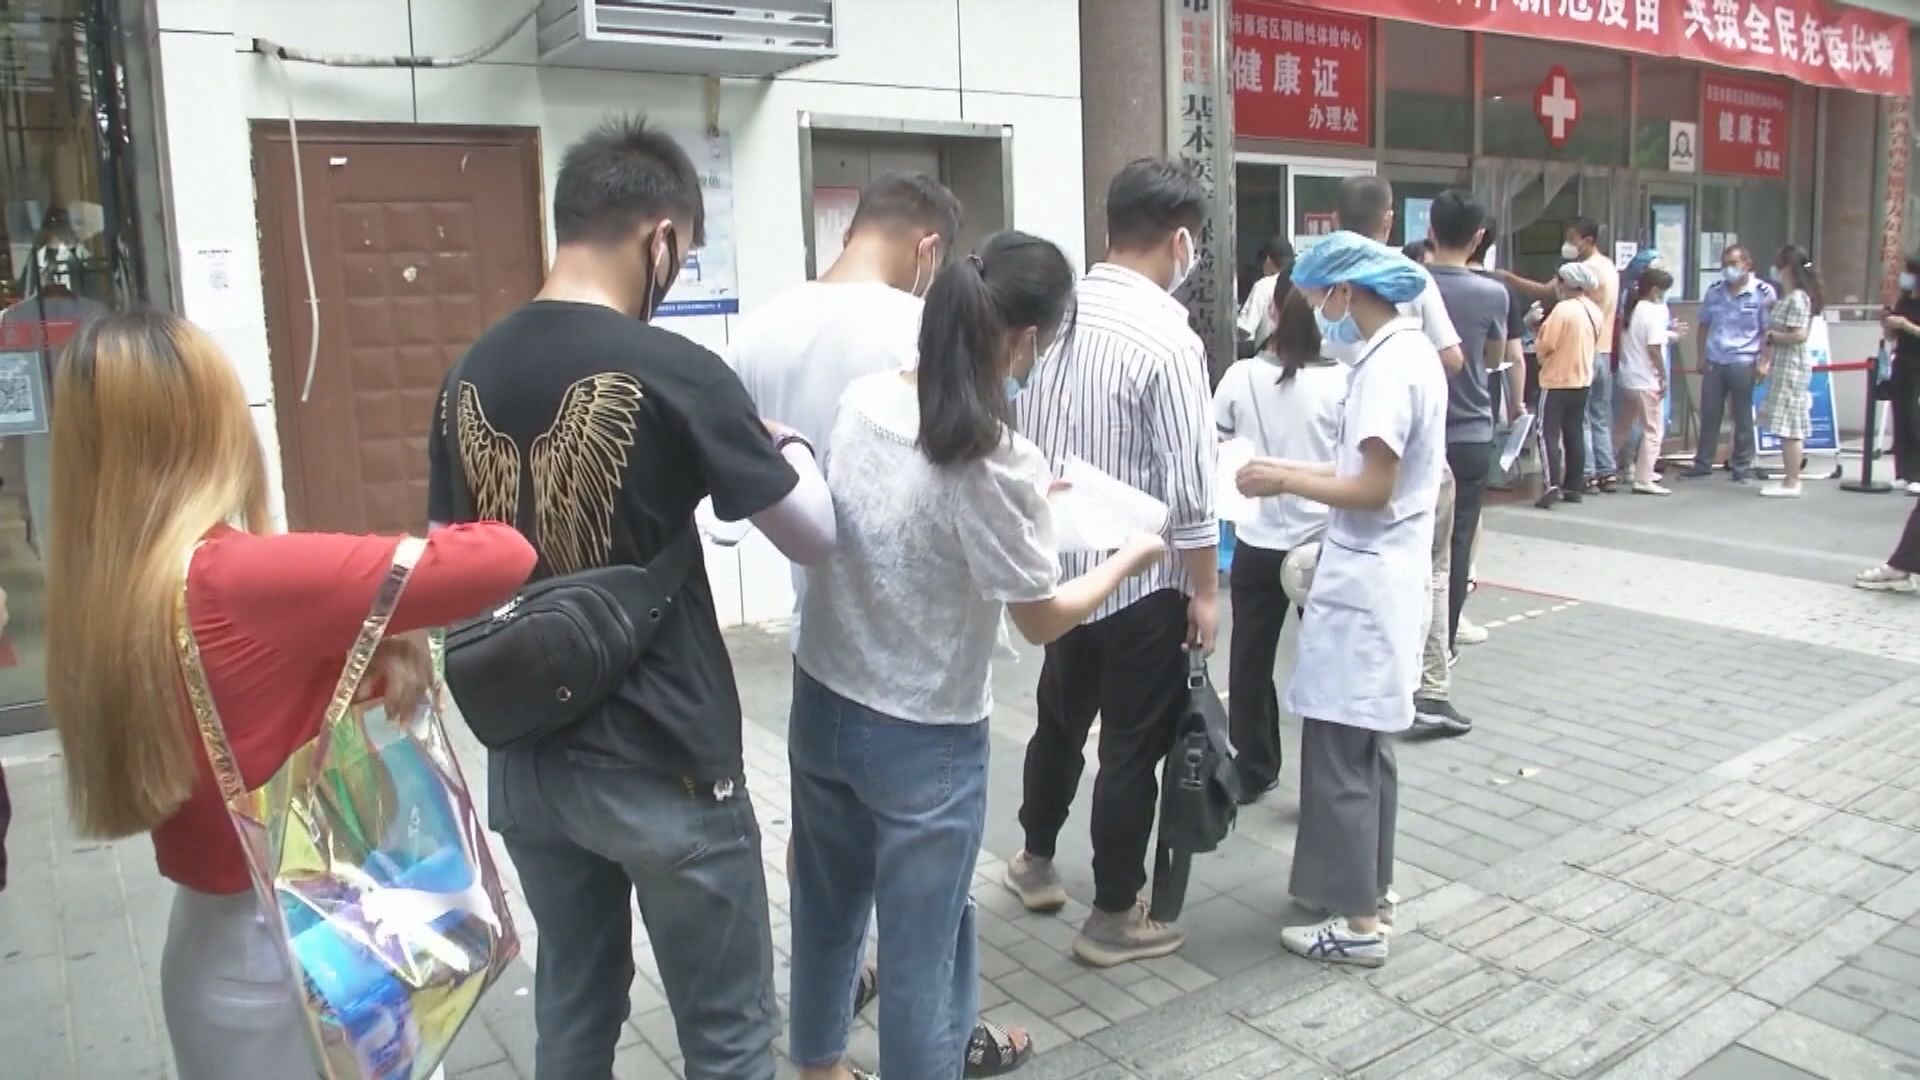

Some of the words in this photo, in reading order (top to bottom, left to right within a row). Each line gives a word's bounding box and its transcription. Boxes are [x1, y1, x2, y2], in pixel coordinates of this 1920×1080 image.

[1233, 46, 1340, 98] 健康证
[1308, 104, 1359, 132] 办理处
